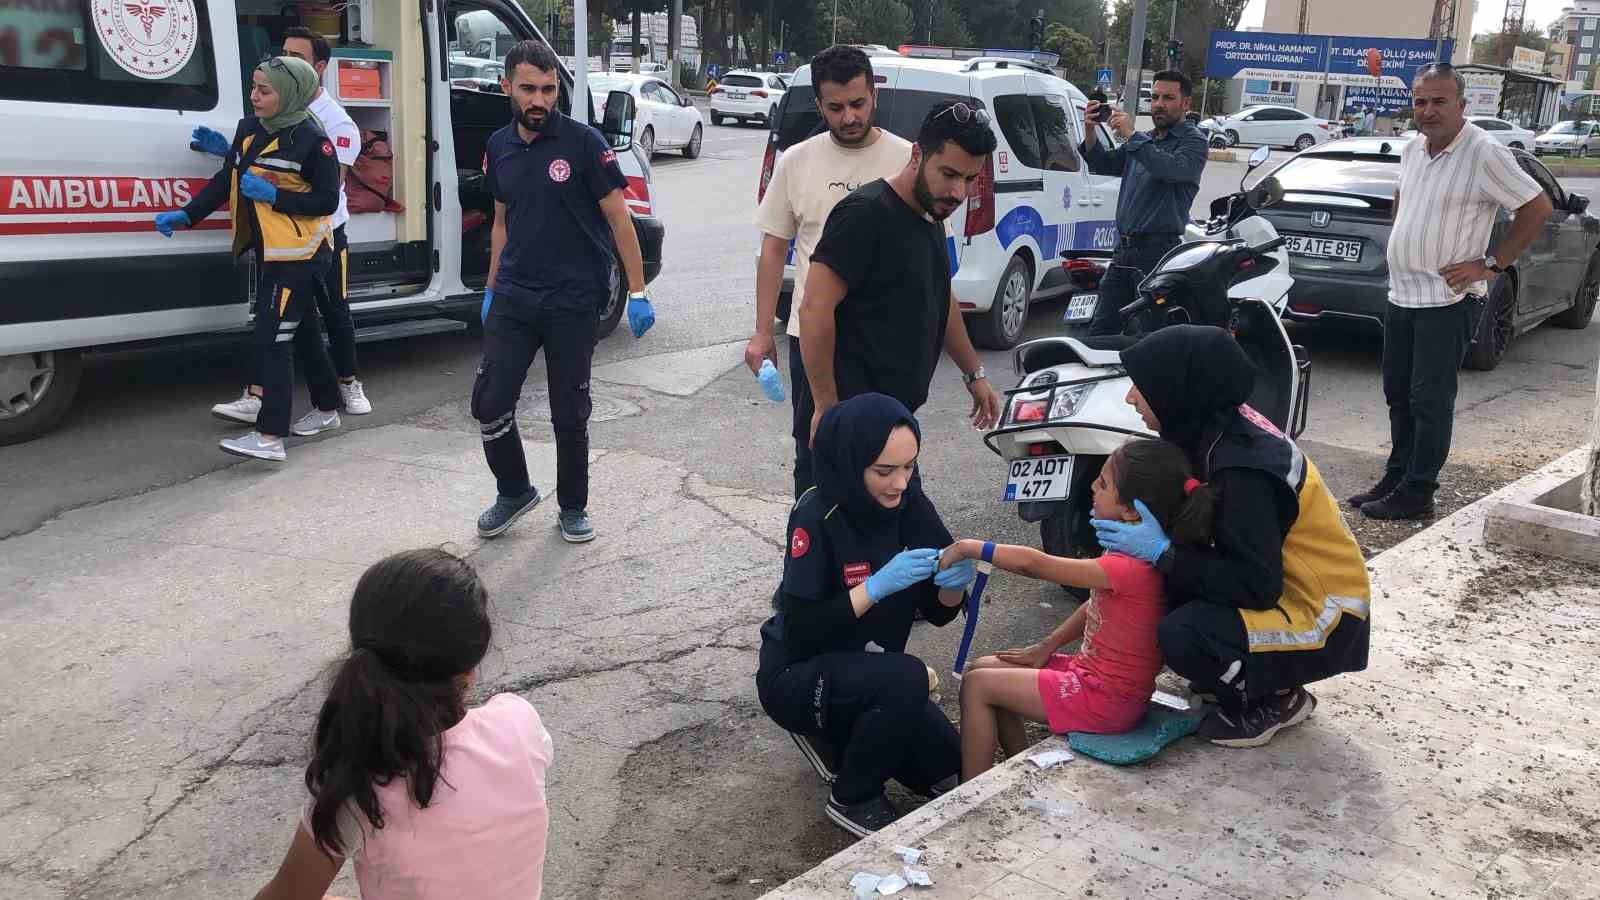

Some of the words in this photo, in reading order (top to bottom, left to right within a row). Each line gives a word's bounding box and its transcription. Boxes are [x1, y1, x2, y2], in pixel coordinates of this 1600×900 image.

[1239, 42, 1252, 50] DR.
[1253, 42, 1276, 52] NİHAL
[1278, 43, 1317, 54] HAMAMCI
[1342, 47, 1369, 56] DİLAR
[1224, 51, 1271, 61] ORTODONTİ
[1271, 54, 1303, 63] UZMANI
[1381, 59, 1405, 69] EKİMİ
[8, 179, 192, 208] AMBULANS
[1285, 237, 1301, 251] 35
[1304, 239, 1334, 254] ATE
[1335, 242, 1360, 257] 815
[1011, 461, 1031, 477] 02
[1033, 458, 1069, 476] ADT
[1022, 479, 1053, 497] 477
